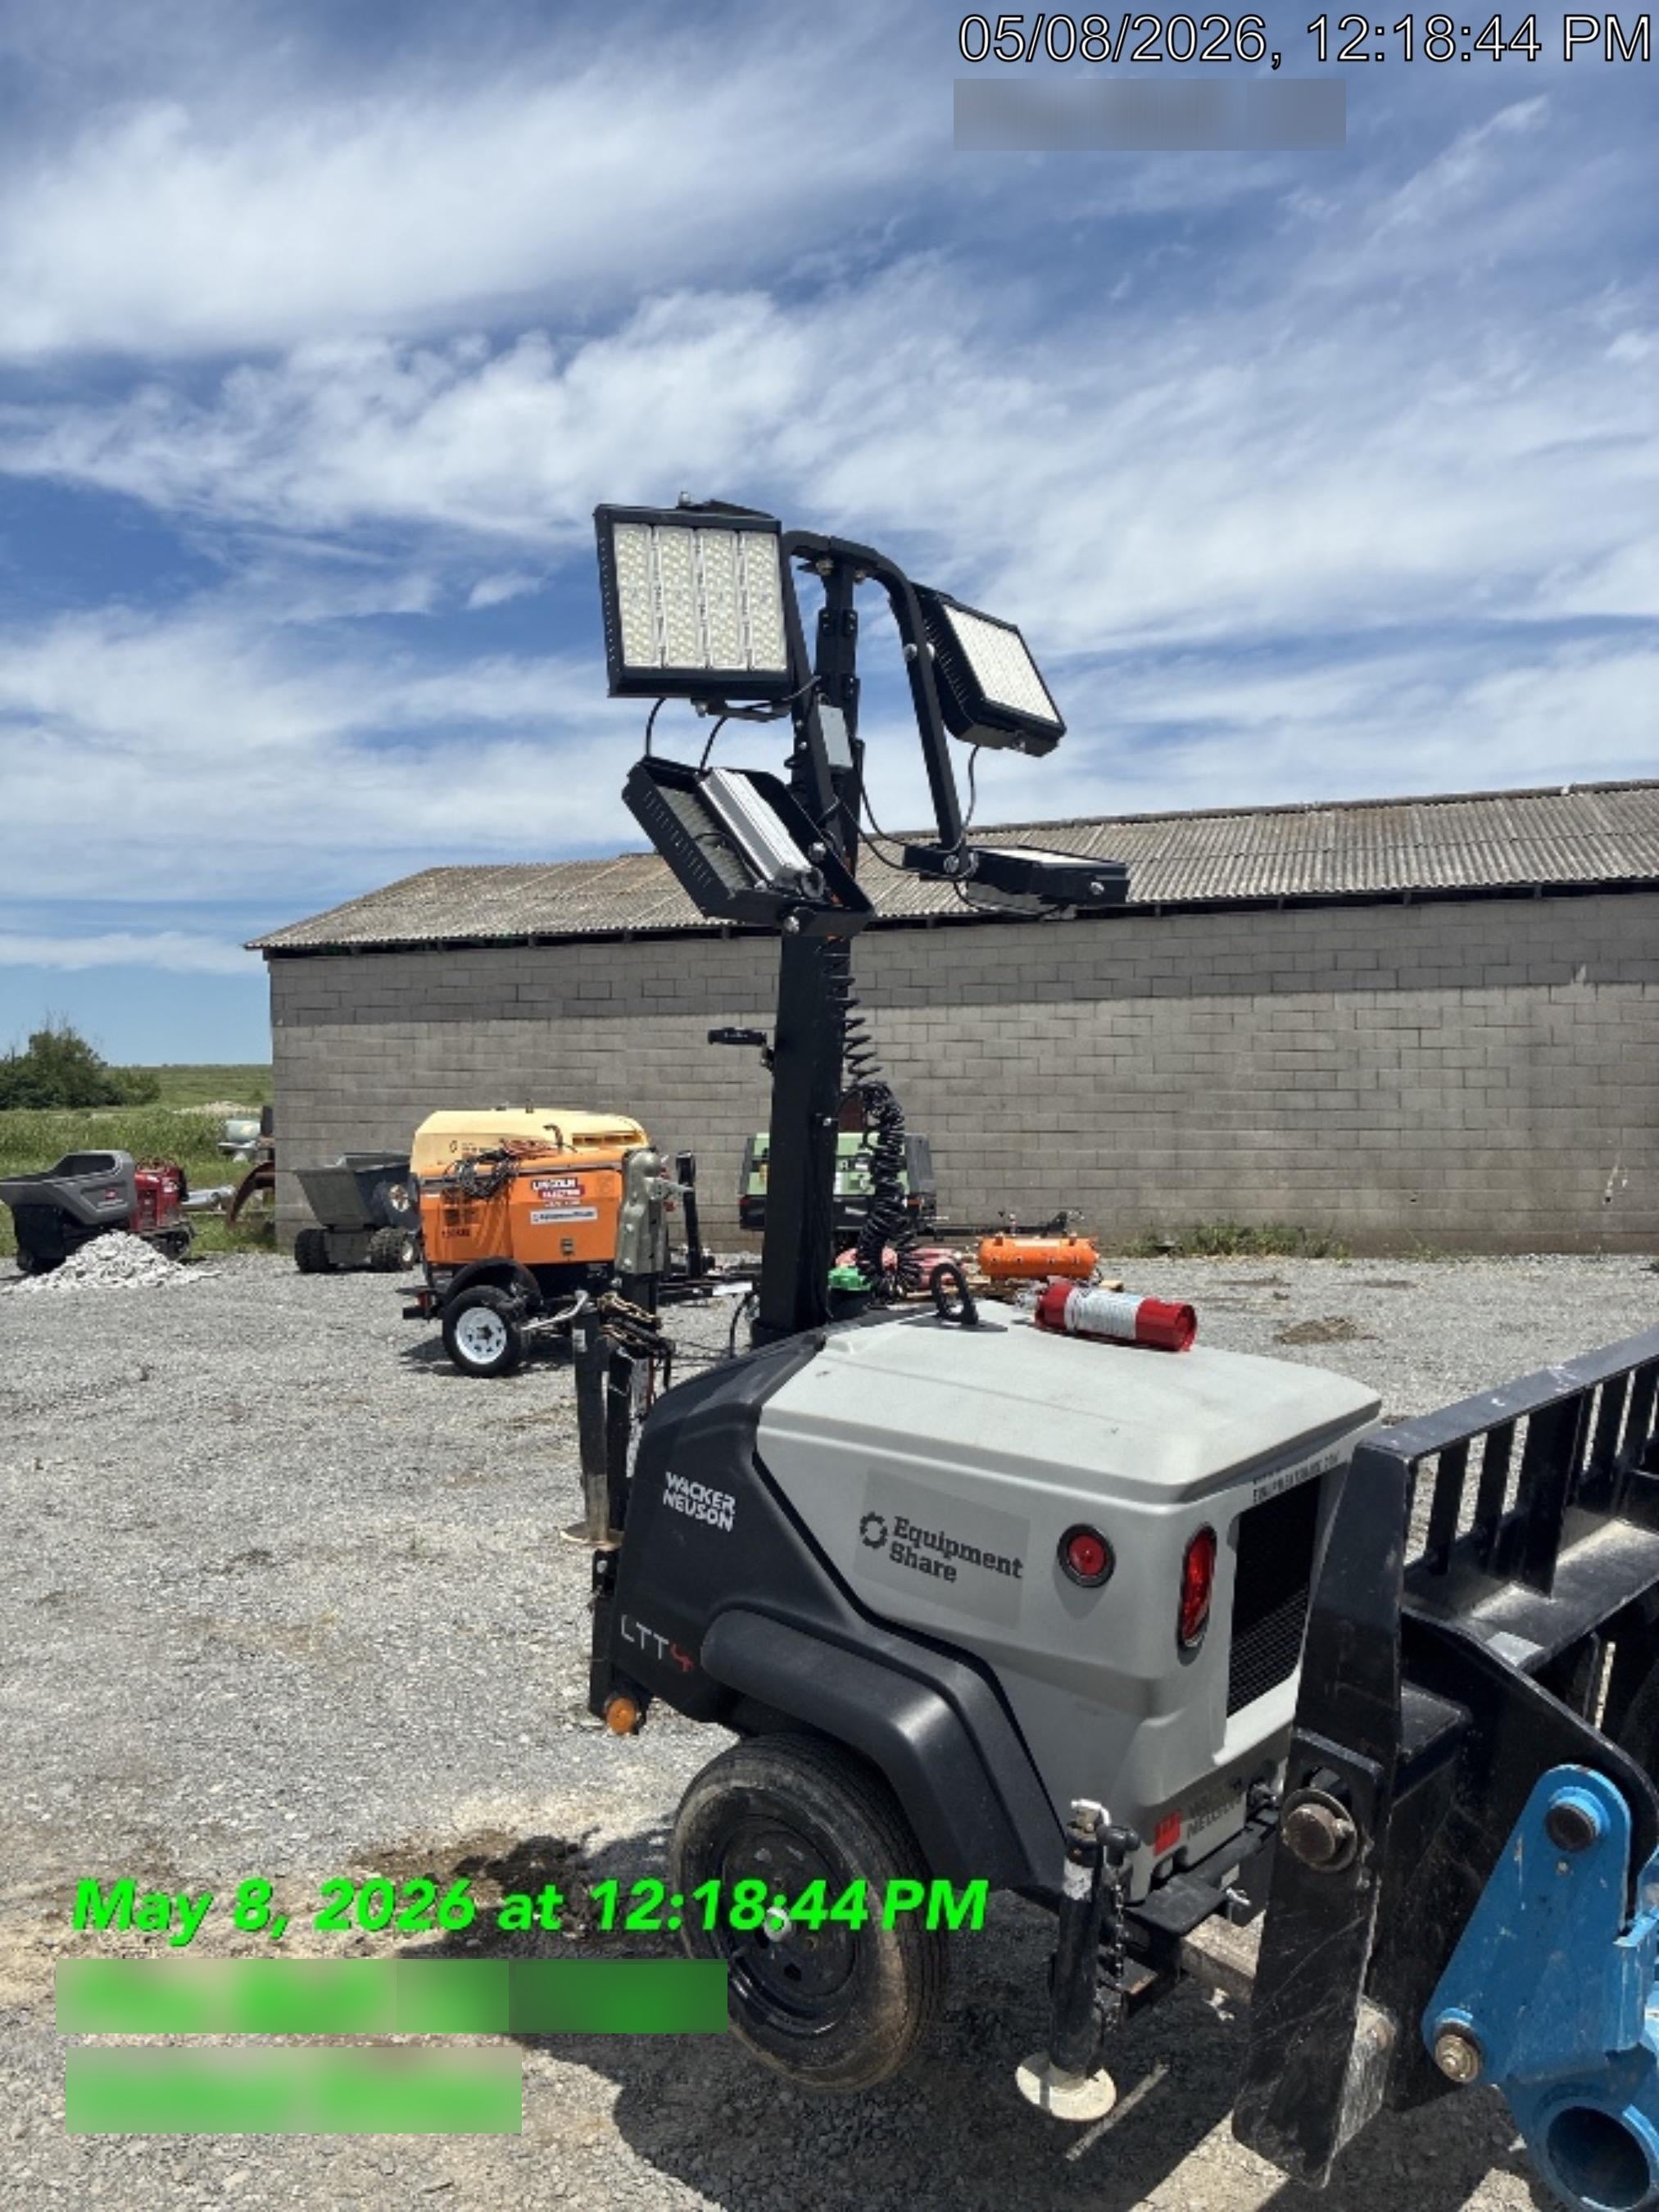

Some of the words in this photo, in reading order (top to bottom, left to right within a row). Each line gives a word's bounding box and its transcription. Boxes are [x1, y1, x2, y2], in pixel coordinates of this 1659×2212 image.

[663, 1489, 734, 1532] NEUSON
[665, 1471, 736, 1516] WACKER
[890, 1540, 957, 1584] Share
[894, 1516, 1023, 1580] Equipment
